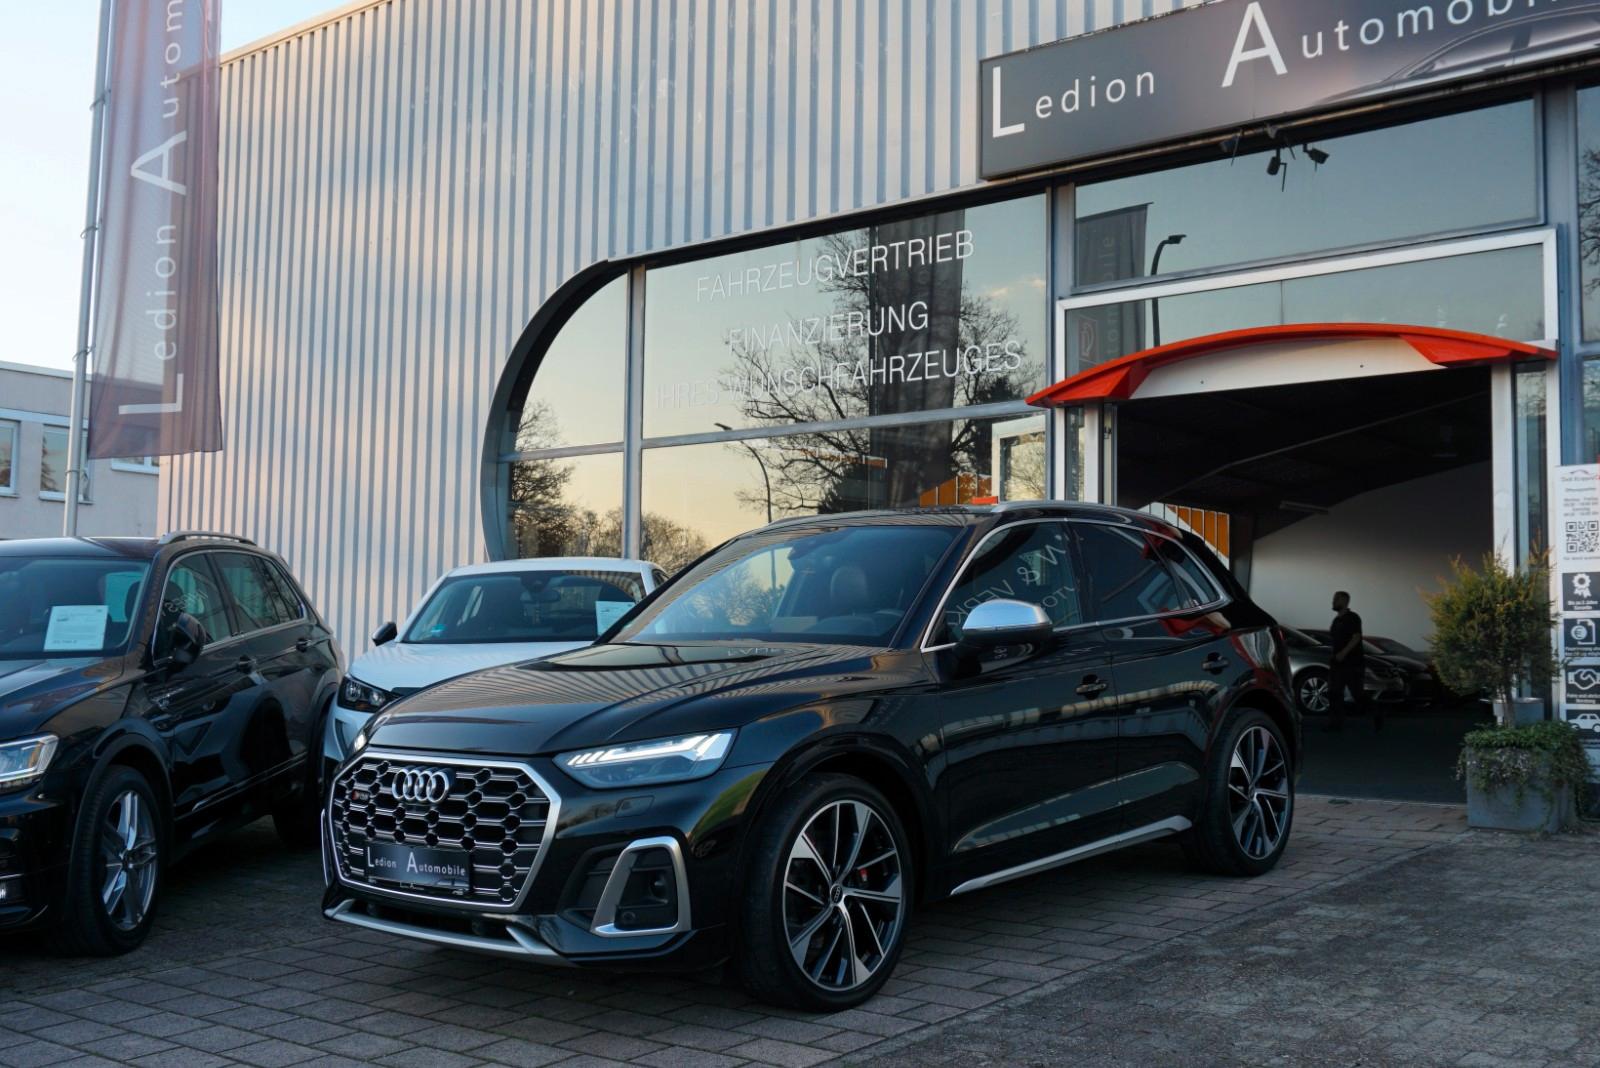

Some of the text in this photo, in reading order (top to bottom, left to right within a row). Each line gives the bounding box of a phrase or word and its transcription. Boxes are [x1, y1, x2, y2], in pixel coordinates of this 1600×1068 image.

[992, 0, 1557, 138] Ledion Automo
[697, 229, 975, 303] FAHRZEUGVERTRIEB
[118, 224, 184, 415] Ledion
[729, 301, 929, 355] FINANZIERUNG
[729, 340, 1022, 401] WUNSCHFAHRZEUGES
[367, 846, 466, 876] Ledion Automobile
